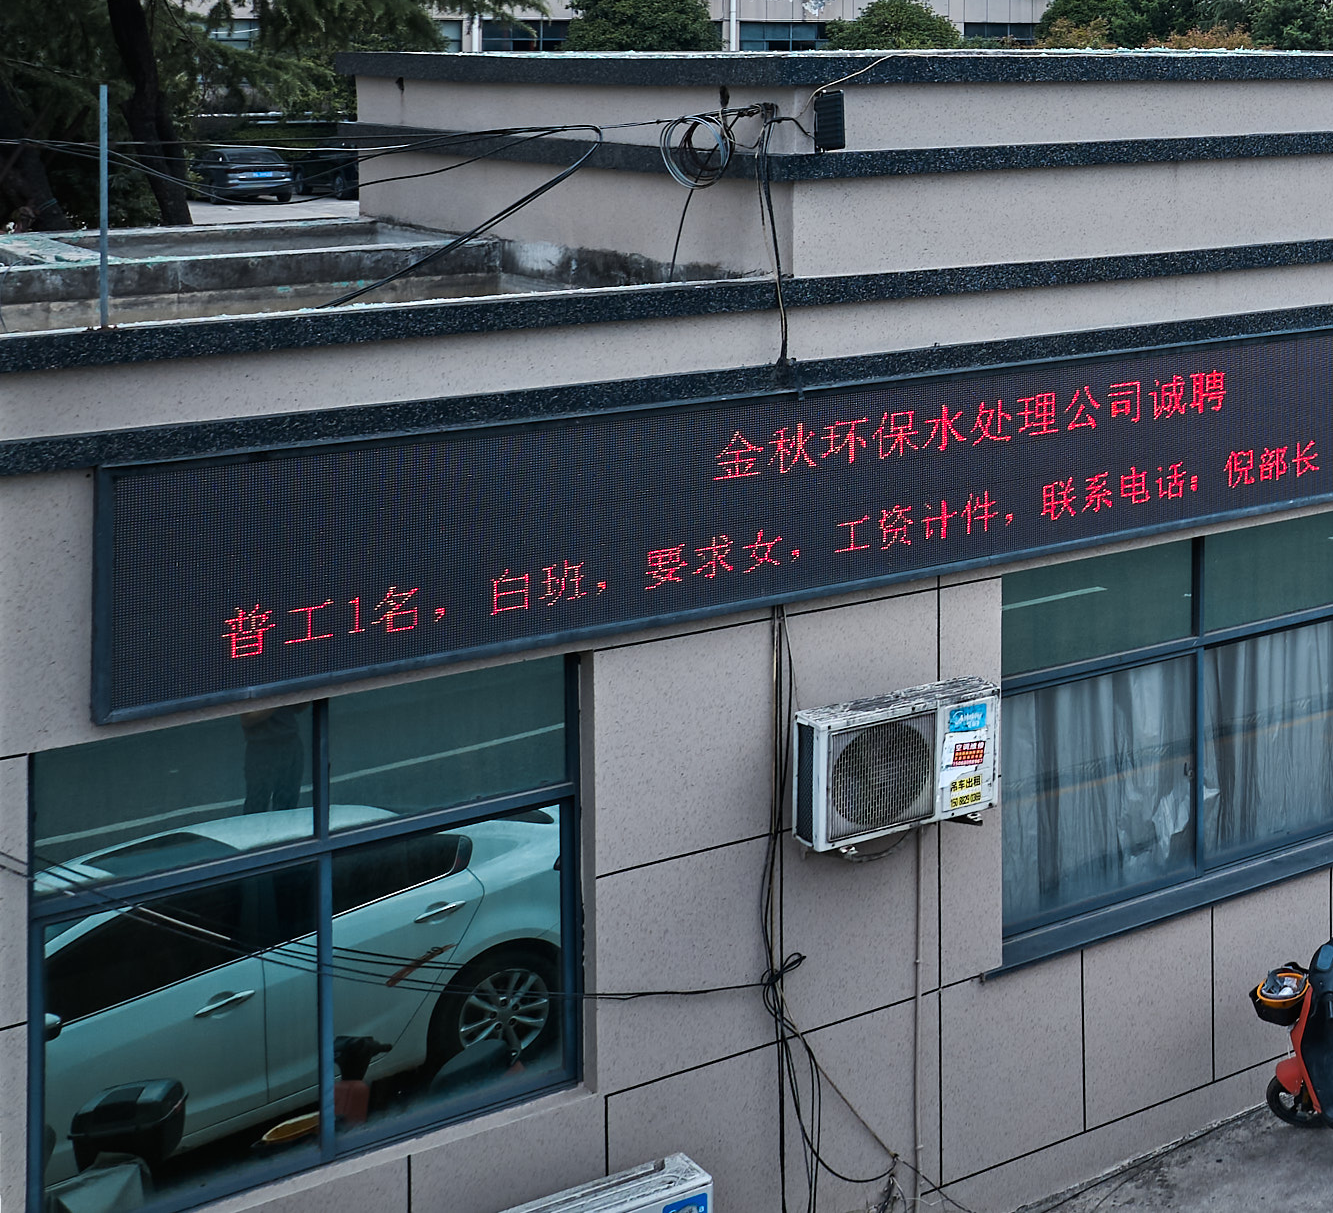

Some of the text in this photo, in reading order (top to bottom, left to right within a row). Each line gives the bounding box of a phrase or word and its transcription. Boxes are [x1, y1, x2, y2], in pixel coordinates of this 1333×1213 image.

[712, 370, 1227, 482] 金秋环保水处理公司诚聘
